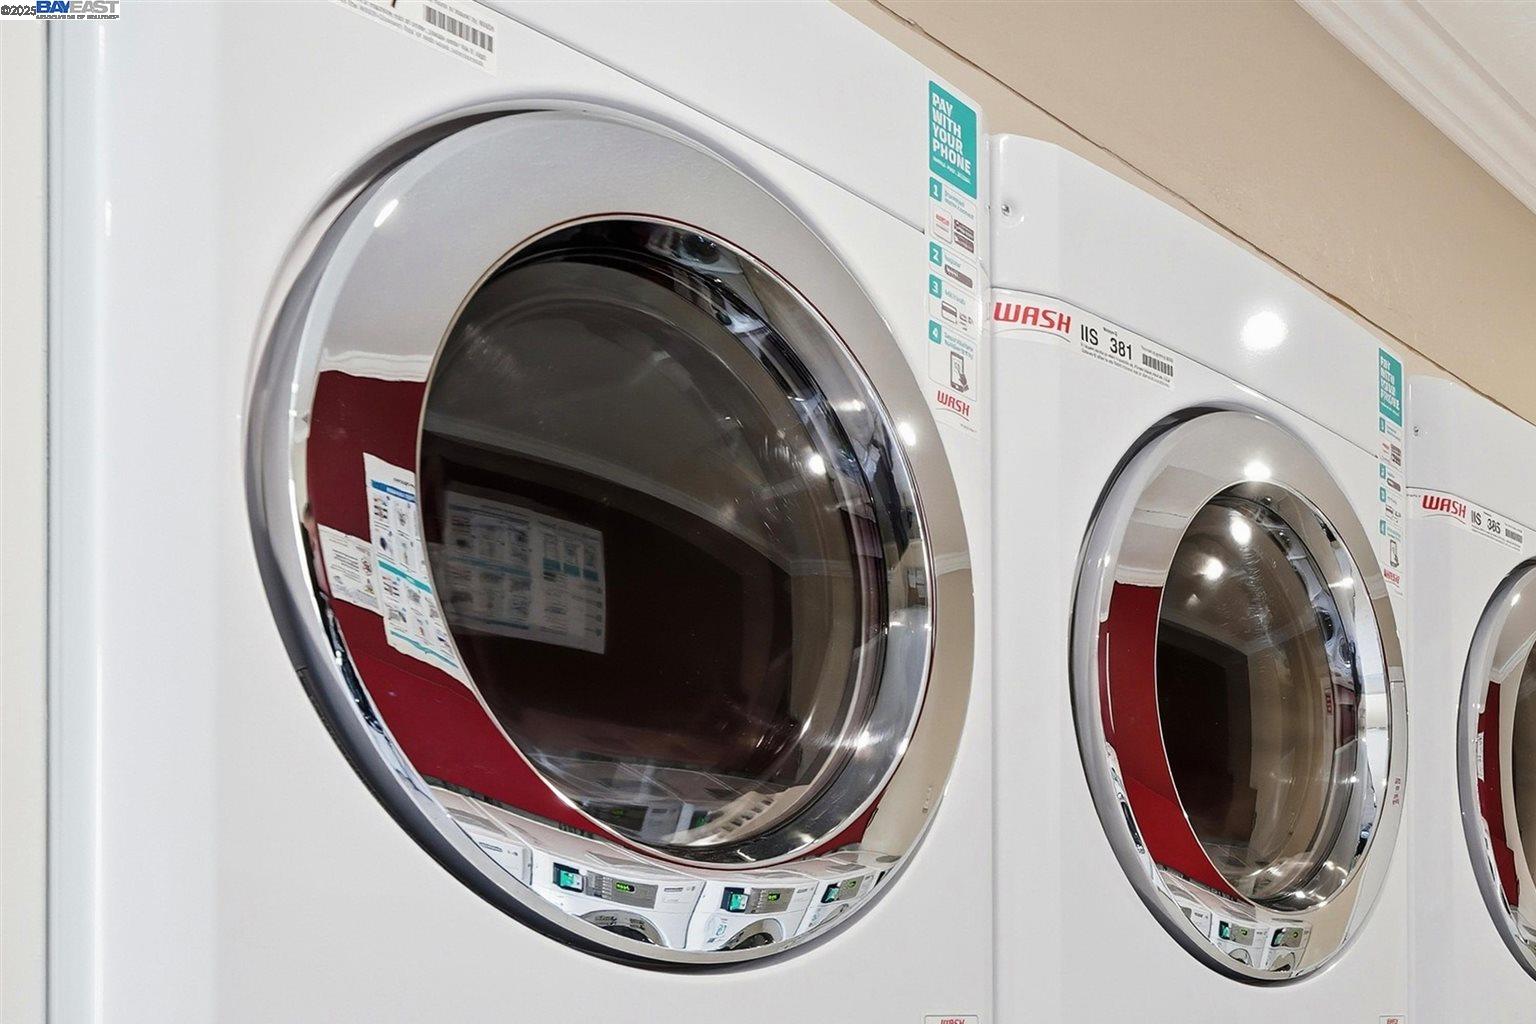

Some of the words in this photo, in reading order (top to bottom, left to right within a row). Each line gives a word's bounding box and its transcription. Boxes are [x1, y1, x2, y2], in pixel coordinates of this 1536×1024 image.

[932, 92, 953, 116] PAY
[932, 107, 961, 139] WITH
[932, 122, 963, 155] YOUR
[932, 141, 971, 175] PHONE
[933, 184, 939, 197] 1
[933, 248, 939, 261] 2
[932, 281, 939, 293] 3
[932, 327, 938, 339] 4
[993, 302, 1071, 334] WASH
[1080, 324, 1099, 346] IIS
[1110, 337, 1132, 360] 381
[937, 390, 970, 417] WASH
[1422, 495, 1467, 518] WASH
